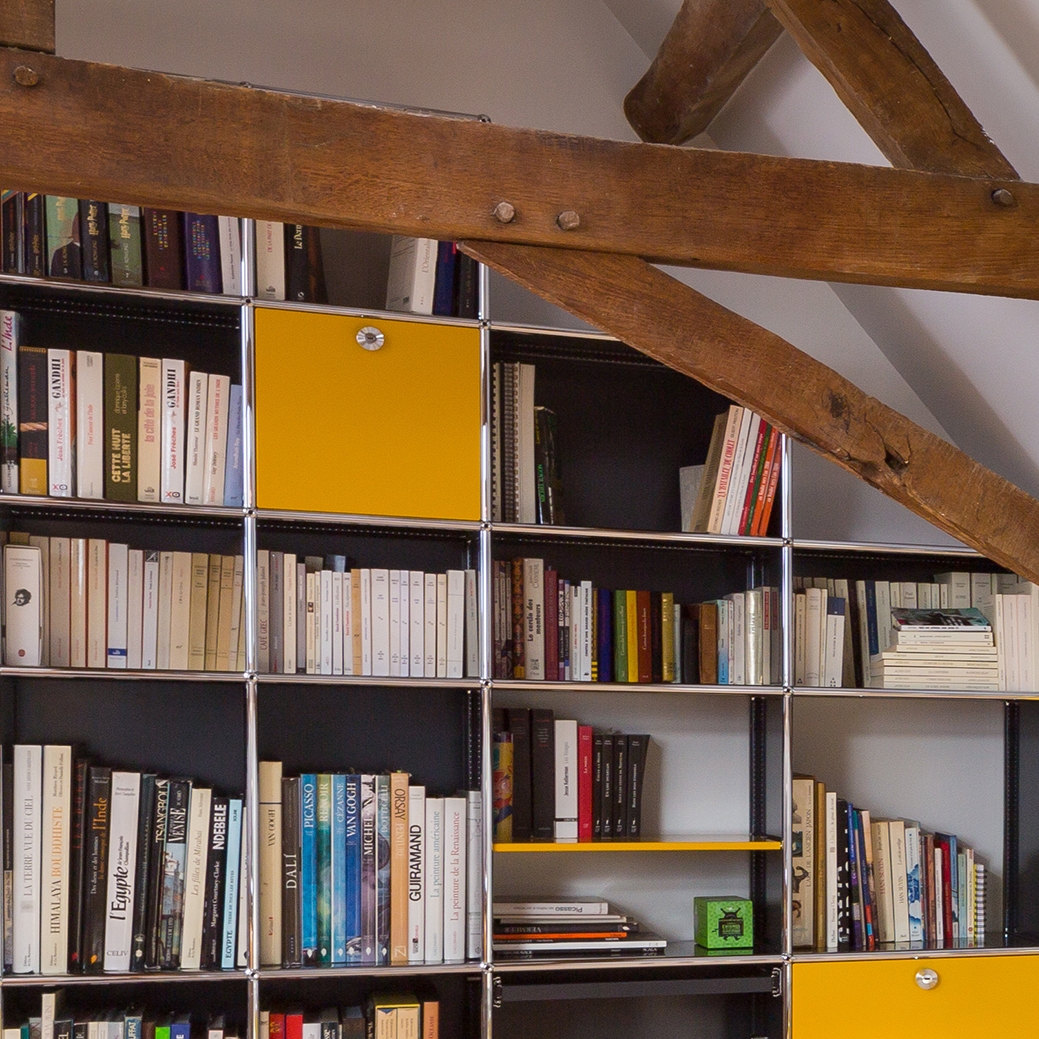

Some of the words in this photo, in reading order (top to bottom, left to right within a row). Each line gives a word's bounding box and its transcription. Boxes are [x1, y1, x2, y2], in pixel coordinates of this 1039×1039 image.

[2, 316, 13, 351] L'Inde
[51, 358, 61, 398] GANDHI
[144, 384, 156, 398] joie
[167, 369, 176, 408] GANDHI
[144, 407, 155, 418] de
[144, 420, 155, 433] cité
[122, 433, 131, 468] LIBERTE
[722, 439, 735, 457] CHOLET
[112, 453, 121, 482] CETTE
[122, 471, 131, 482] LA
[24, 796, 33, 816] CIEL
[304, 784, 314, 828] PICASSO
[320, 783, 329, 822] RENOIR
[336, 783, 344, 822] CÉZANNE
[347, 783, 356, 814] GOGH
[24, 820, 33, 830] DU
[93, 798, 107, 830] l'Inde
[168, 808, 186, 842] VENISE
[212, 804, 227, 850] NDEBELE
[268, 809, 276, 830] GOGH
[347, 816, 355, 836] VAN
[24, 834, 33, 850] VUE
[51, 806, 62, 877] BOUDDHISTE
[432, 811, 441, 851] américaine
[451, 812, 460, 856] Renaissance
[23, 854, 33, 882] TERRE
[284, 853, 297, 889] DALÍ
[409, 824, 421, 901] GUIRAMAND
[431, 855, 443, 886] peinture
[451, 859, 459, 867] la
[451, 870, 459, 879] de
[24, 885, 32, 896] LA
[109, 866, 131, 920] l'Egypte
[191, 885, 199, 896] Les
[430, 889, 439, 898] La
[451, 881, 462, 909] peinture
[50, 880, 61, 934] HIMALAYA
[451, 912, 459, 921] La
